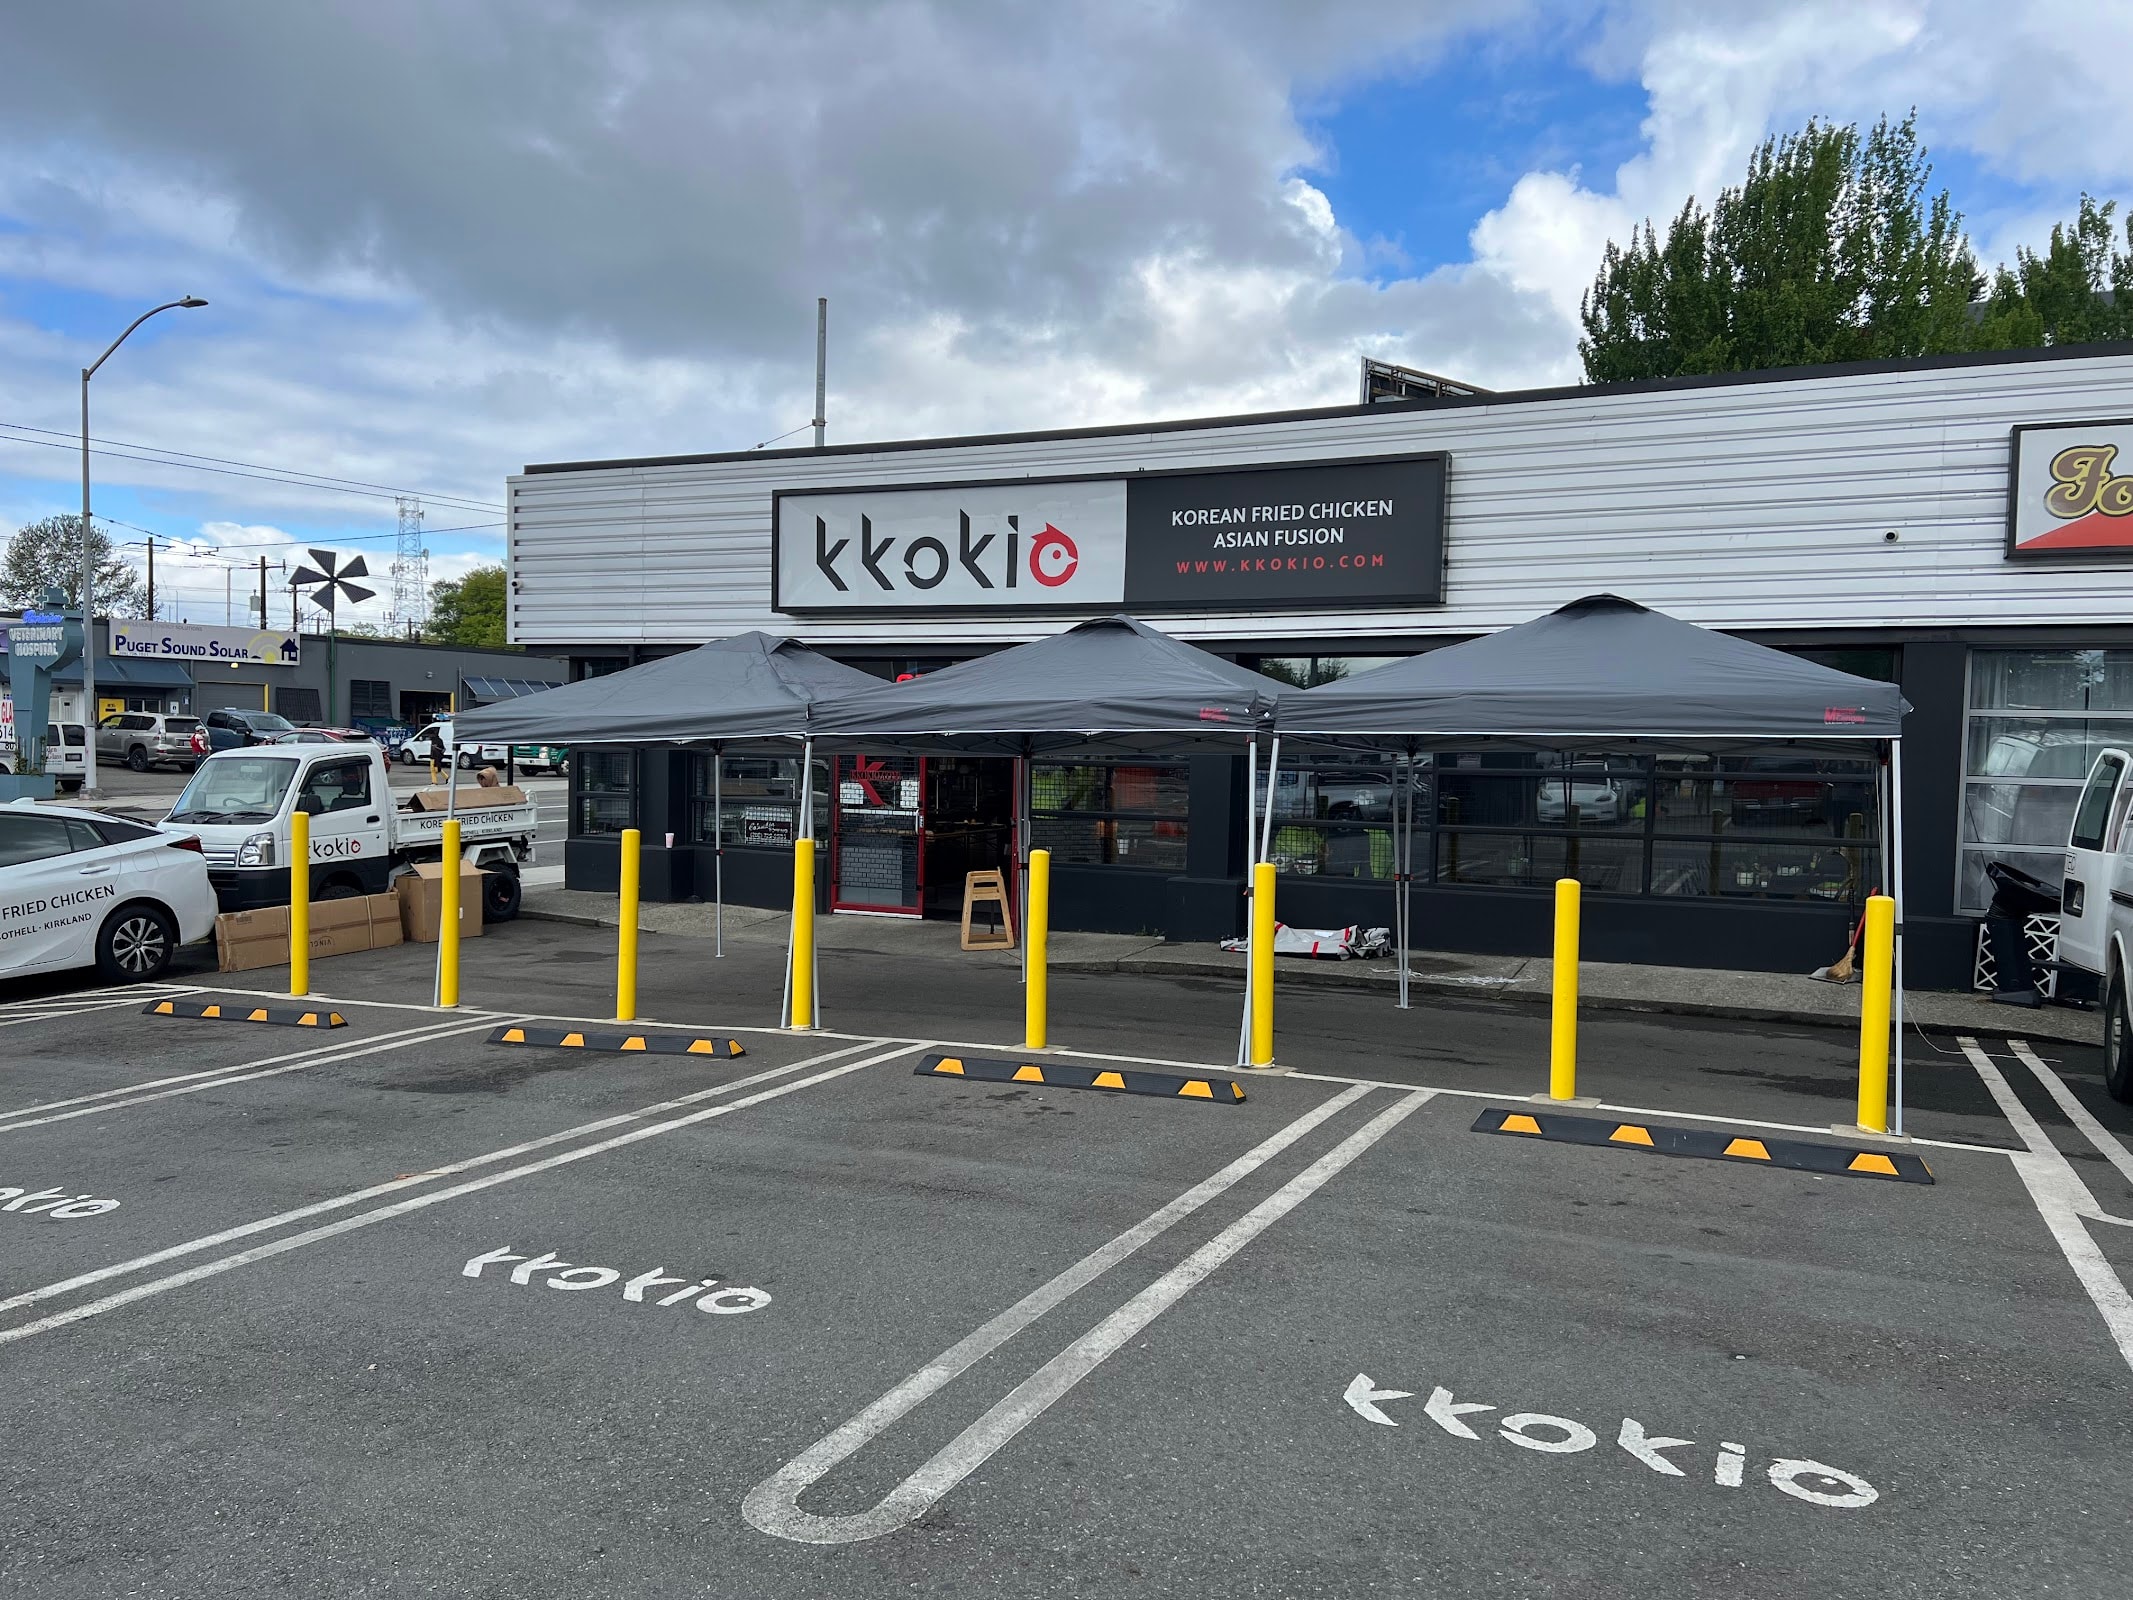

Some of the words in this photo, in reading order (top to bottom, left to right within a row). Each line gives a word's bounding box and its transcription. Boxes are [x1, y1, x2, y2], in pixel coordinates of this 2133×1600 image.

[2042, 444, 2133, 520] Jo
[1171, 507, 1246, 526] KOREAN
[1251, 504, 1305, 523] FRIED
[1309, 499, 1393, 519] CHICKEN
[816, 508, 1079, 591] kkokio
[1213, 530, 1268, 549] ASIAN
[1274, 528, 1344, 546] FUSION
[9, 627, 64, 641] VETERINARY
[115, 634, 159, 653] PUGET
[161, 637, 206, 656] SOUND
[209, 640, 249, 659] SOLAR
[15, 642, 58, 656] HOSPITAL
[420, 819, 444, 830] KORE
[480, 813, 514, 824] CHICKEN
[308, 838, 361, 859] kokio
[2, 900, 47, 920] FRIED
[50, 884, 115, 909] CHICKEN
[0, 925, 38, 940] OTHELL
[44, 913, 92, 930] KIRKLAND
[462, 1245, 772, 1315] kkokio
[1342, 1372, 1880, 1509] kkokio
